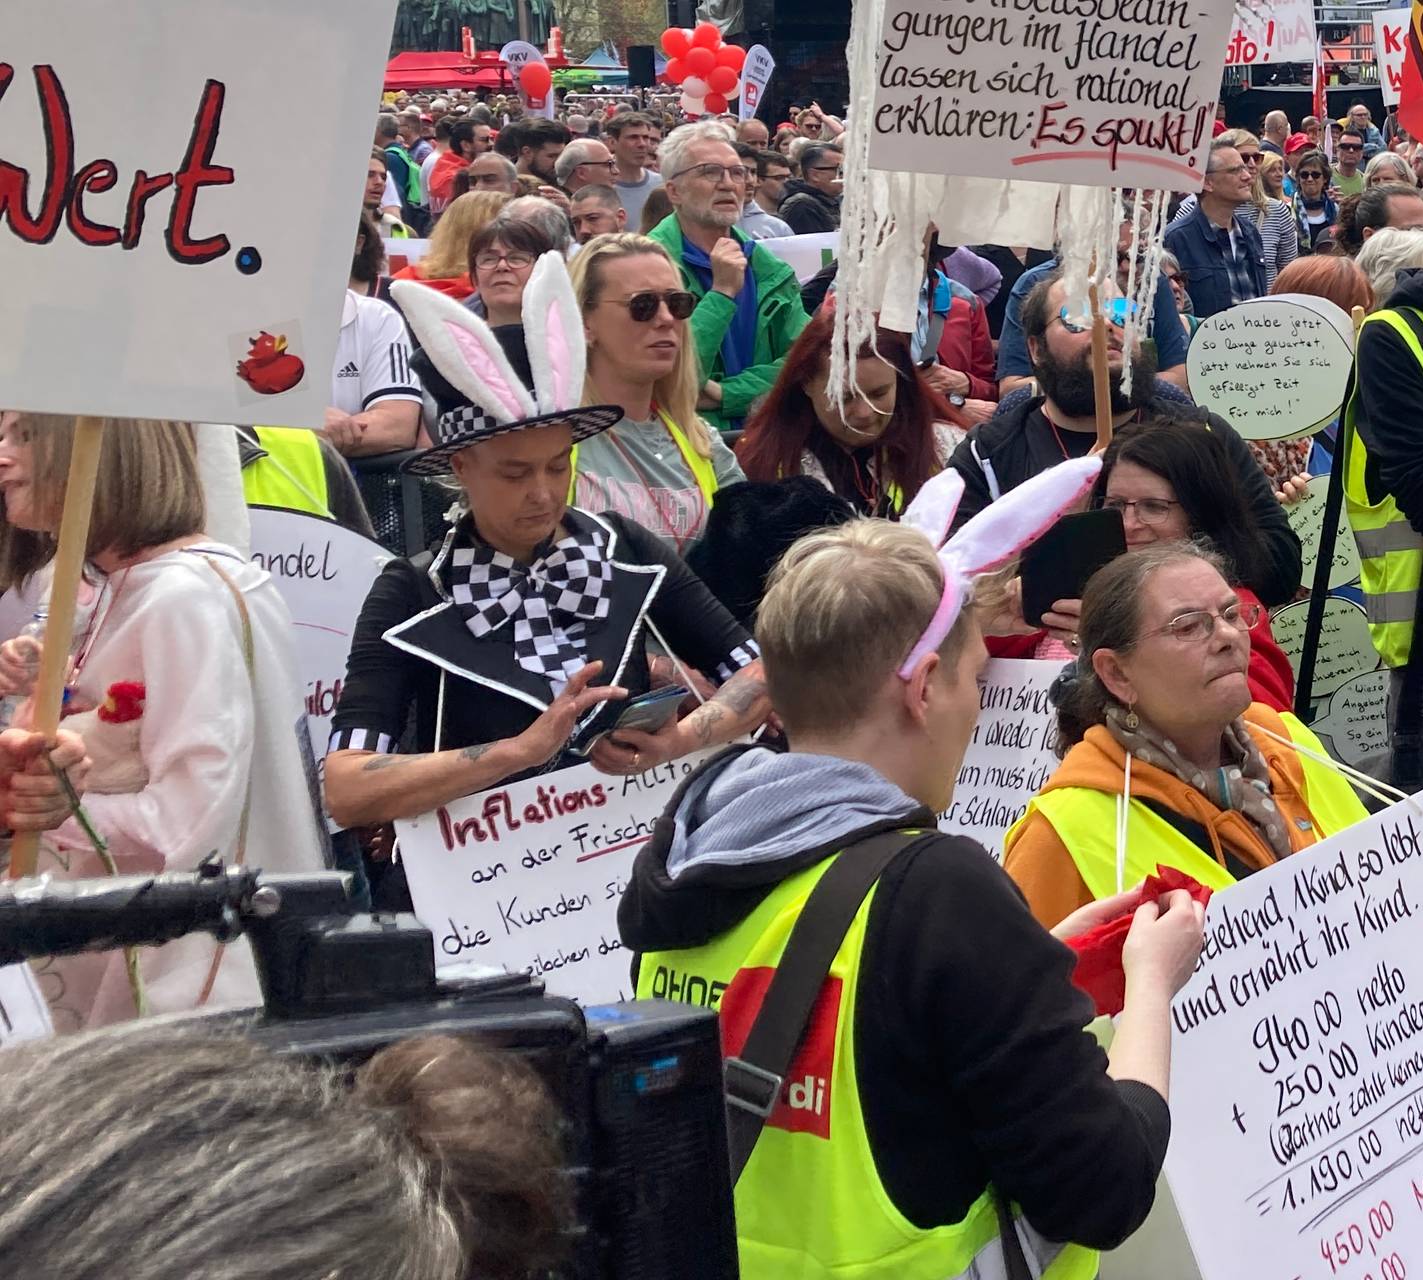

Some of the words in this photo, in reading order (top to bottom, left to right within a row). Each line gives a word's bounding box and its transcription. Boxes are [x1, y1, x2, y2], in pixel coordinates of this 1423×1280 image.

[884, 11, 1013, 55] gungen
[1023, 14, 1062, 52] im
[1065, 20, 1200, 71] Handel
[879, 54, 980, 94] lassen
[986, 61, 1058, 99] sich
[1076, 67, 1198, 111] rational
[874, 94, 1034, 141] erklären:
[0, 63, 262, 275] Wert.
[1224, 339, 1257, 354] lange
[1243, 315, 1281, 328] habe
[1290, 315, 1322, 336] jetzt
[1200, 362, 1228, 376] jetzt
[1235, 361, 1277, 370] nehmen
[1256, 405, 1282, 416] mich
[978, 685, 1013, 711] um
[985, 718, 1039, 750] wieder
[984, 766, 1025, 790] muss
[472, 862, 508, 884] an
[521, 842, 563, 868] der
[1381, 814, 1422, 866] lebt
[441, 918, 491, 954] die
[497, 892, 592, 935] Kunden
[1172, 974, 1227, 1034] und
[1230, 930, 1318, 1007] ernährt
[1317, 913, 1350, 958] ihr
[1354, 878, 1419, 938] Kind.
[1252, 991, 1342, 1074] 940,00
[1357, 960, 1406, 1016] netto
[788, 1075, 825, 1116] di
[1275, 1042, 1359, 1117] 250,00
[1349, 1072, 1387, 1117] zahlt
[1282, 1129, 1383, 1211] 1.190,00
[1320, 1200, 1395, 1275] 450,00
